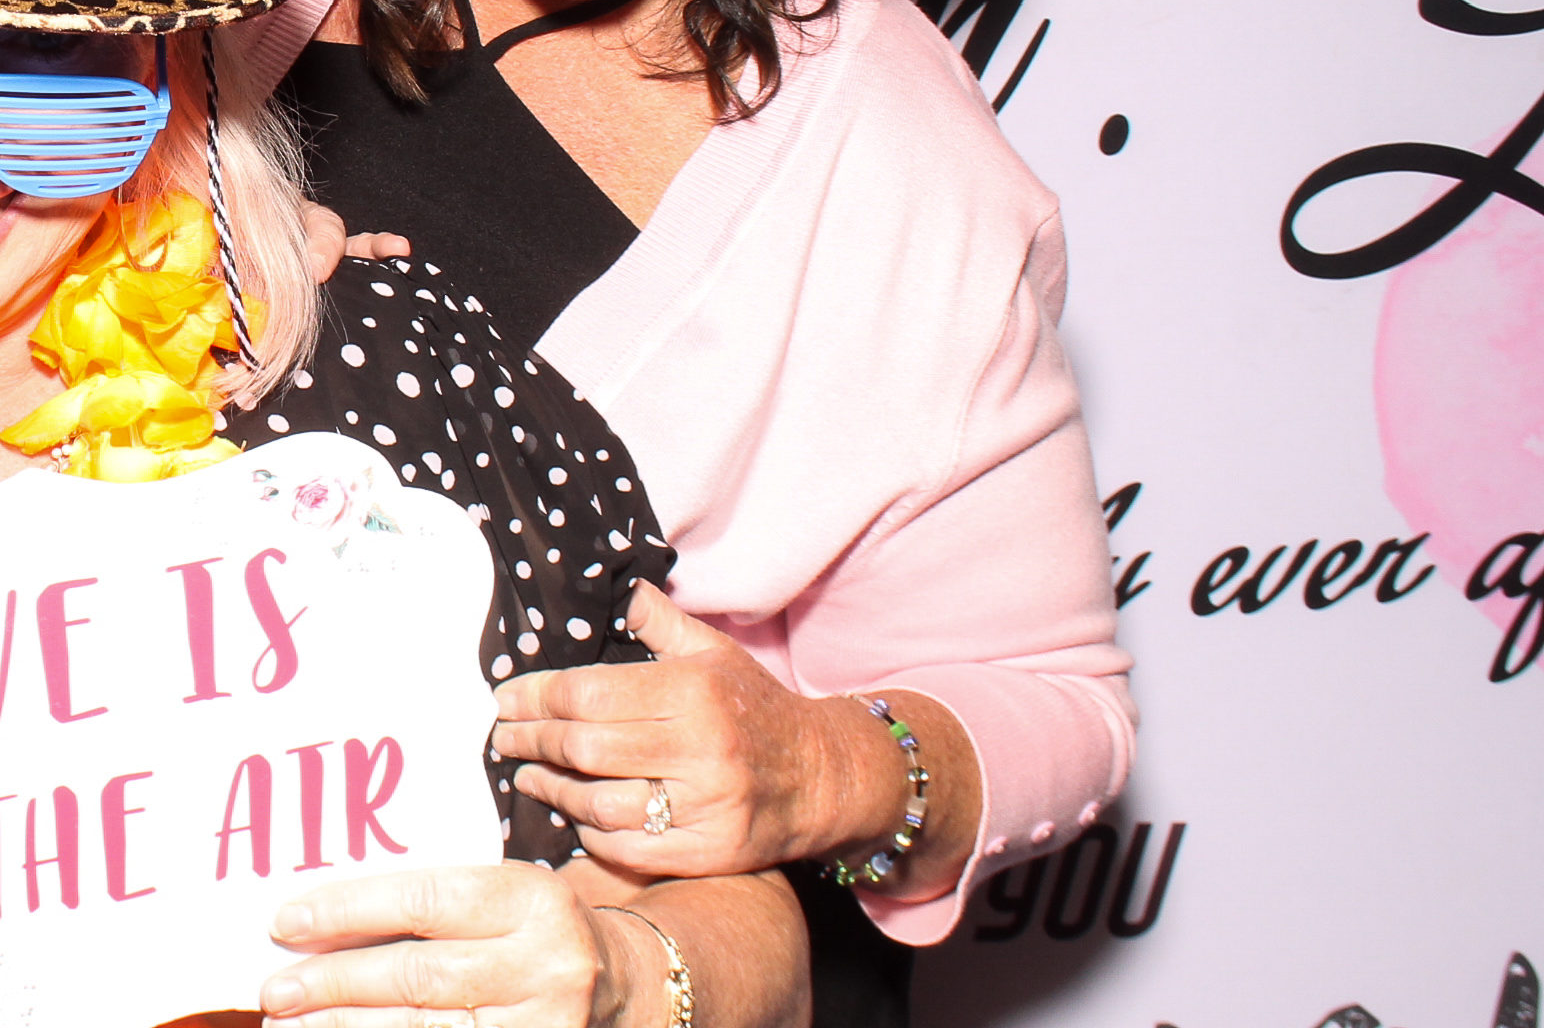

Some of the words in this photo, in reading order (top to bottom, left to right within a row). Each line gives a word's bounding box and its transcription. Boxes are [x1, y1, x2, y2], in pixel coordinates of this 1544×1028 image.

[165, 547, 308, 705] IS
[1190, 533, 1437, 617] ever
[215, 736, 410, 883] AIR
